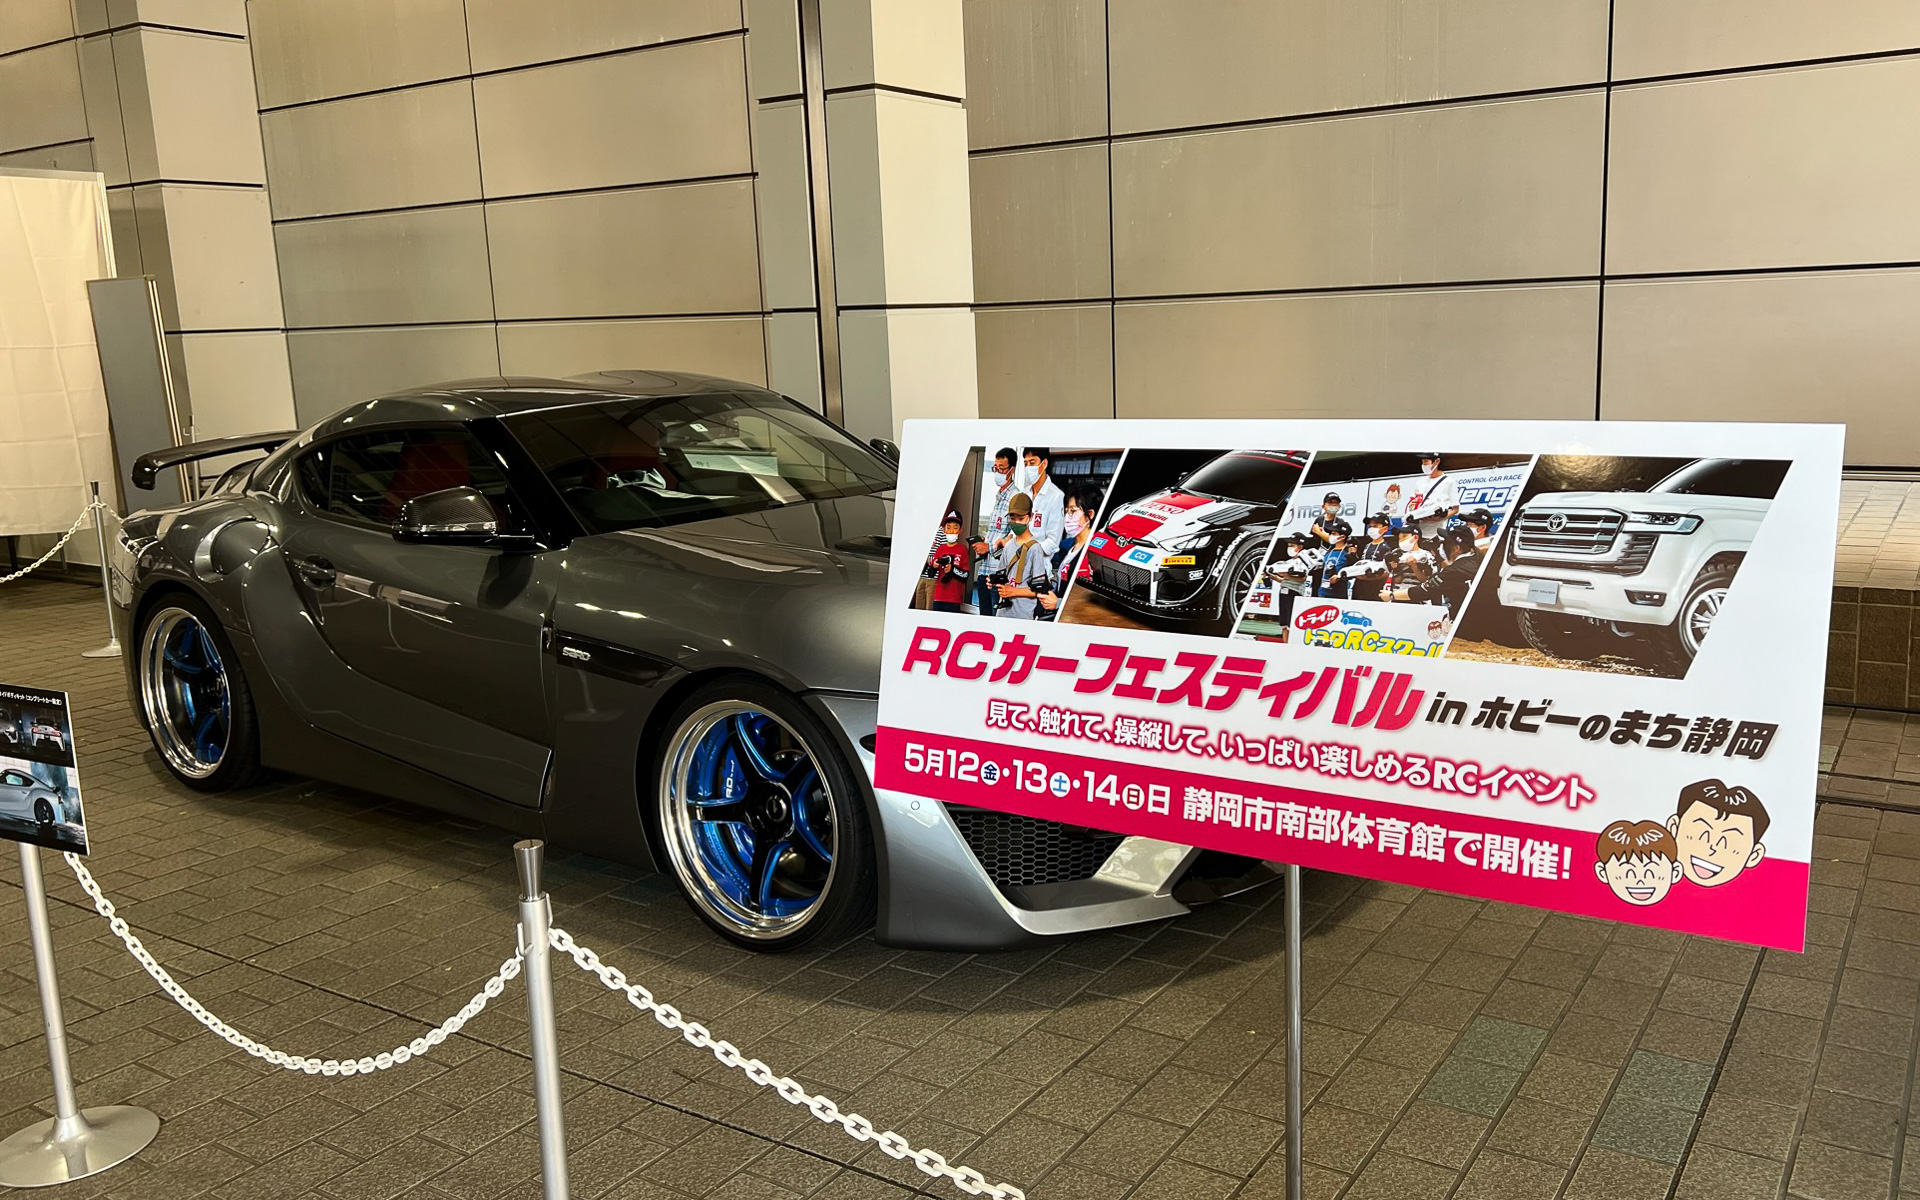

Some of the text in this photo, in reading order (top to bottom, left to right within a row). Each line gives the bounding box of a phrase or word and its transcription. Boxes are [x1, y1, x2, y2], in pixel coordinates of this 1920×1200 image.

[1457, 485, 1519, 508] lenge
[1458, 477, 1487, 485] CONTROL
[1140, 501, 1186, 514] DENSO
[1147, 512, 1168, 521] MORI
[1212, 530, 1252, 578] Panasonic
[902, 626, 1779, 761] RCカーフェスティバル in ホビーのまち静岡
[986, 702, 1594, 809] 見て、触れて、操縦して、いっぱい楽しめるRCイベント
[1183, 785, 1572, 881] 静岡市南部体育館で開催!
